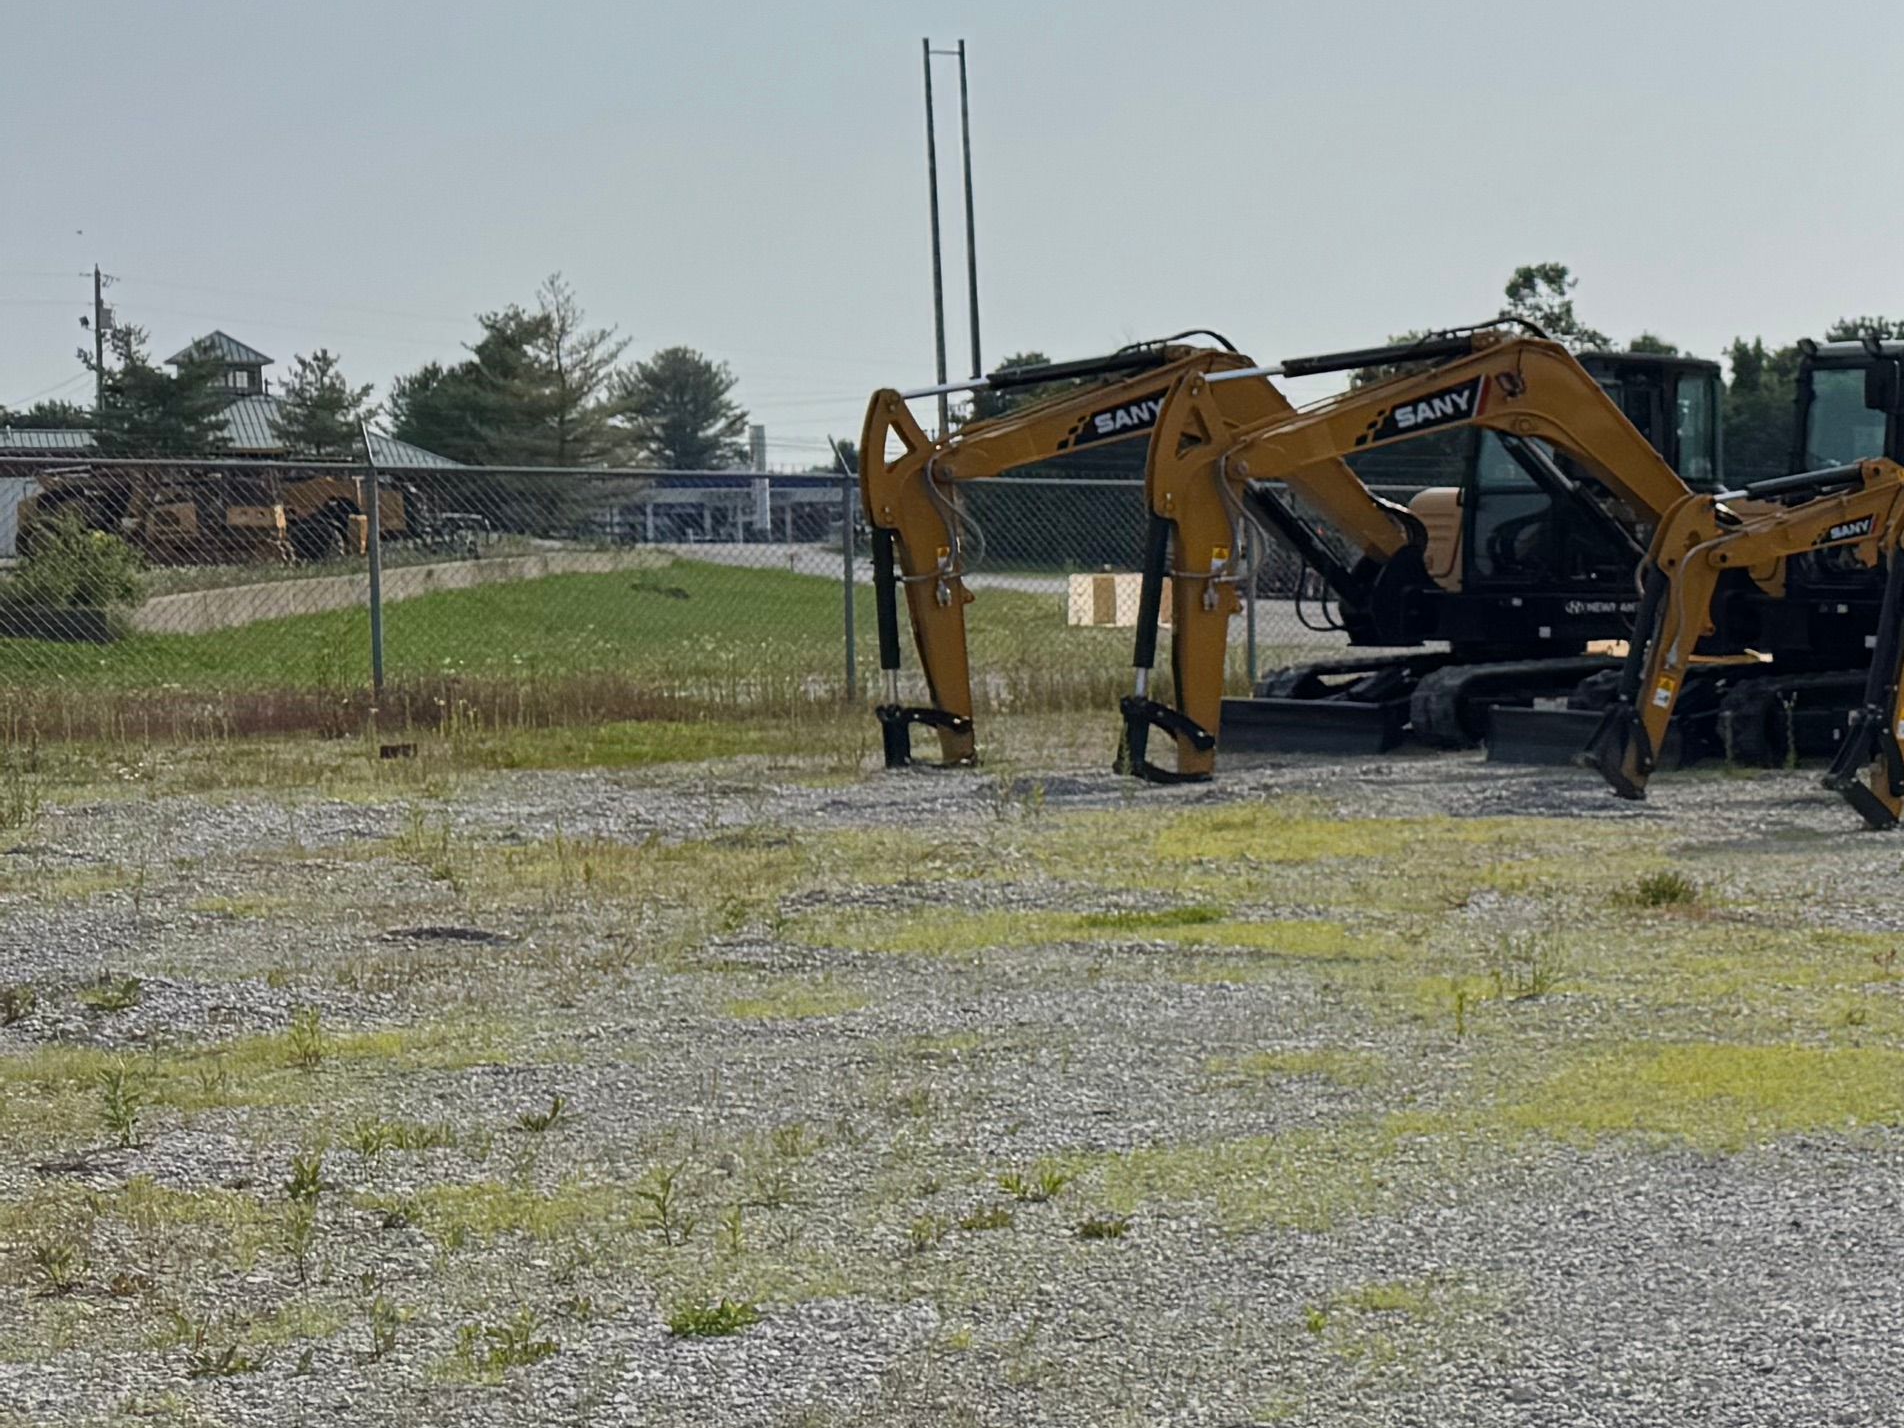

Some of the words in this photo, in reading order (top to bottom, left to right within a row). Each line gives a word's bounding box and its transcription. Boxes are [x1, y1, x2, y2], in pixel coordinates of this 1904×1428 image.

[1094, 398, 1165, 434] SANY
[1394, 389, 1471, 429] SANY
[1830, 519, 1870, 540] SANY
